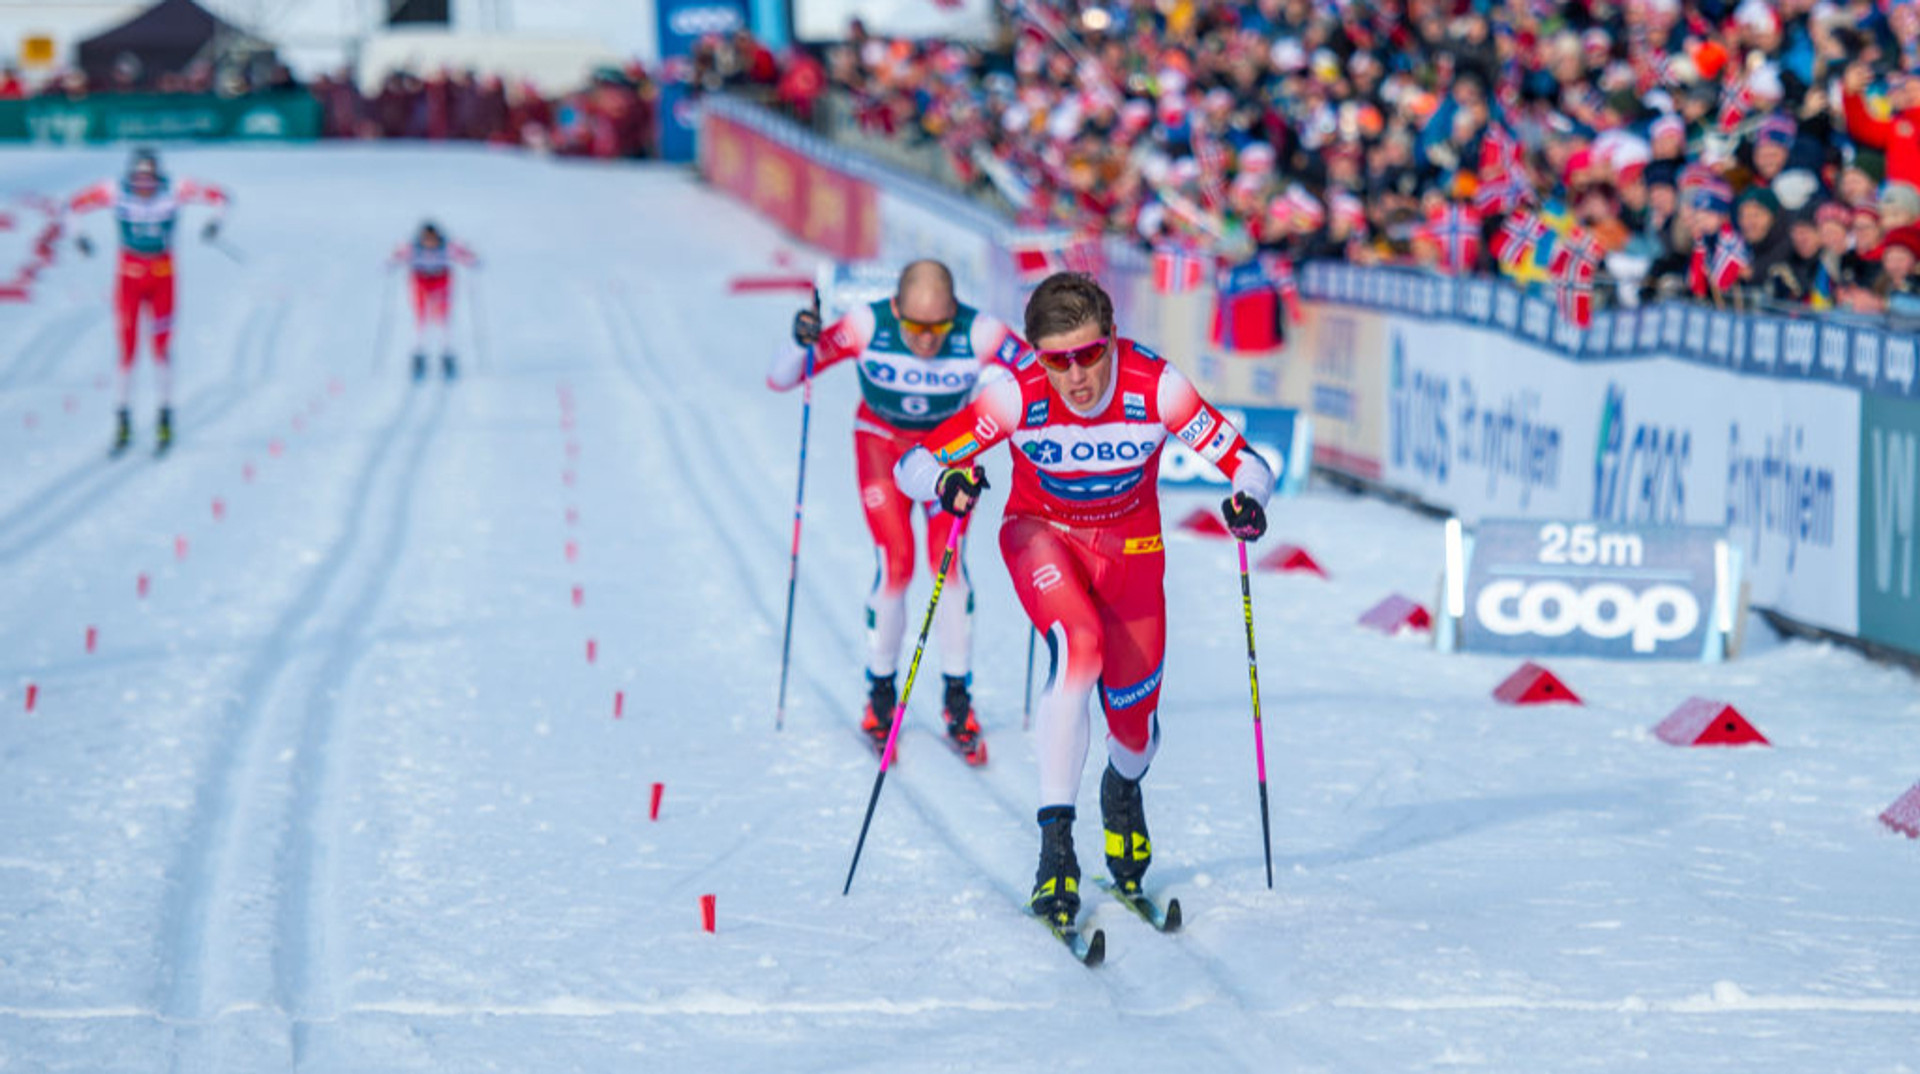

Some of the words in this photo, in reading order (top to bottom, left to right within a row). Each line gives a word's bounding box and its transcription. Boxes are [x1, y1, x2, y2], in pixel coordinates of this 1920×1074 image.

[901, 396, 928, 415] 6
[1181, 410, 1209, 441] BDO
[1071, 441, 1156, 461] OBOS
[1539, 524, 1643, 565] 25m
[1476, 581, 1699, 652] coop
